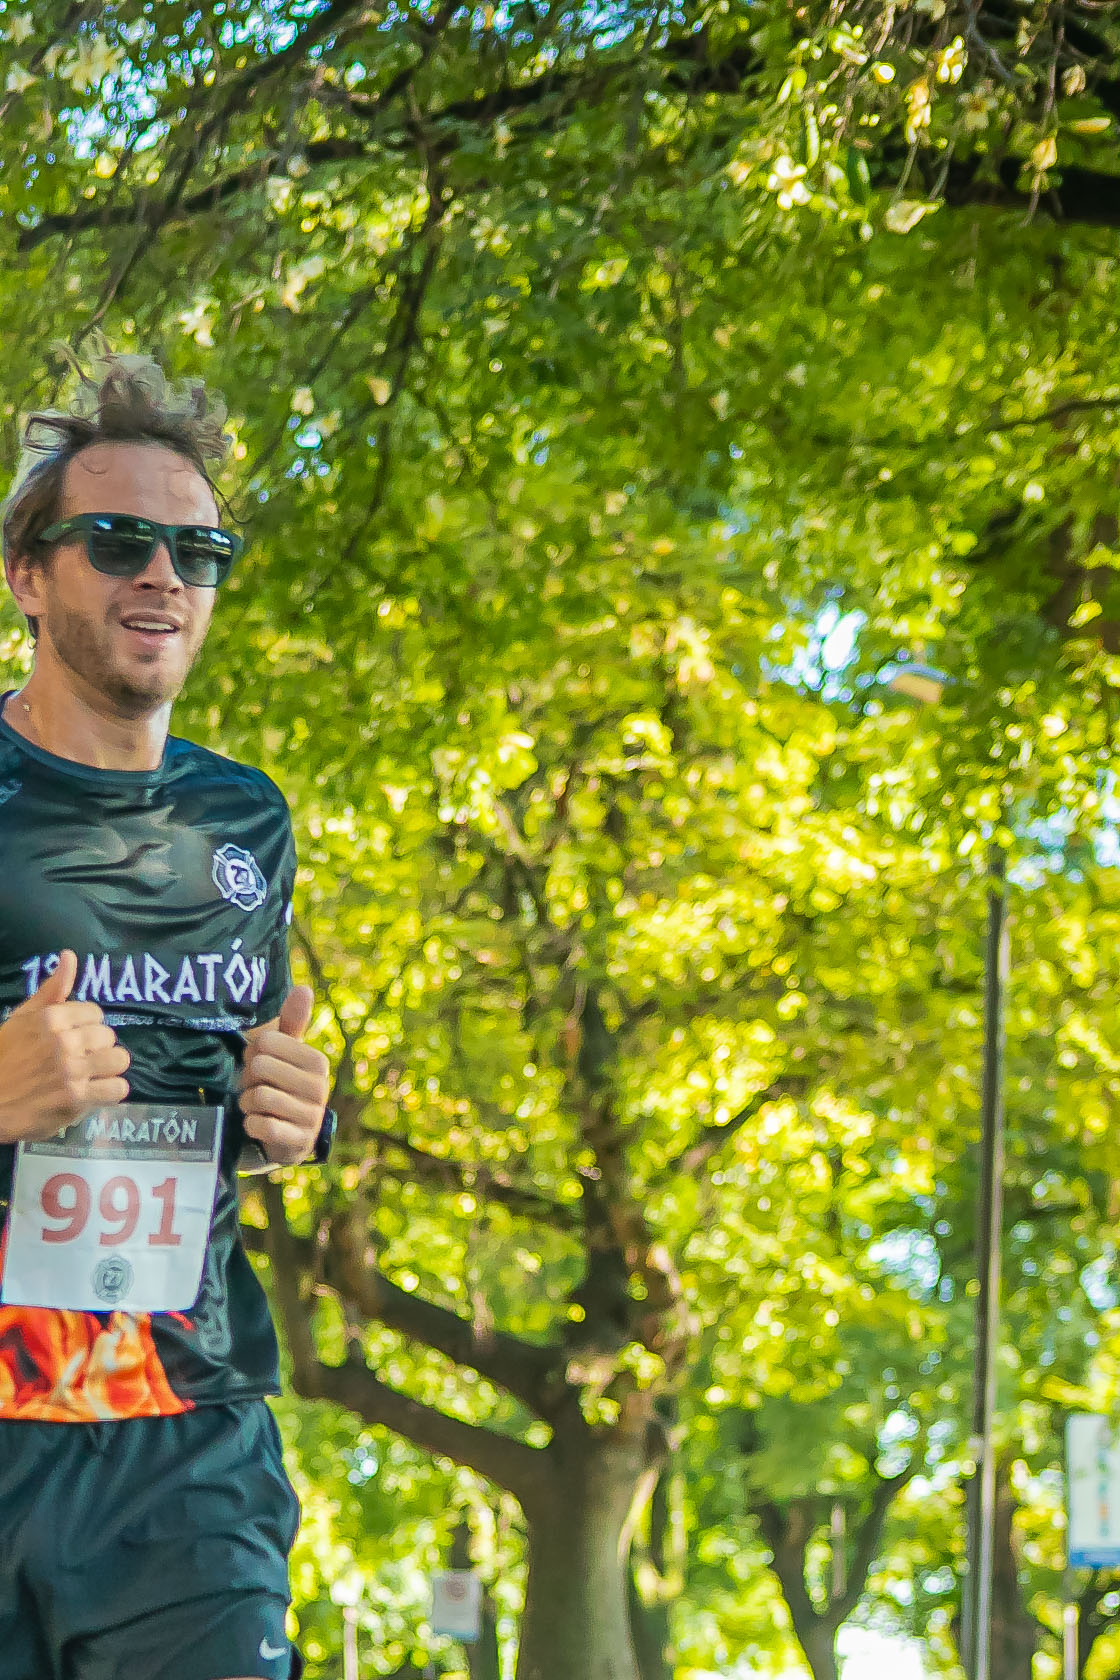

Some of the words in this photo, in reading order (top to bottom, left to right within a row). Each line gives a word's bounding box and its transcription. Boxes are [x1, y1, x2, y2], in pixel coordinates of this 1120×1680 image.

[77, 937, 269, 1004] MARATÓN
[85, 1110, 198, 1145] MARATÓN
[40, 1172, 182, 1248] 991
